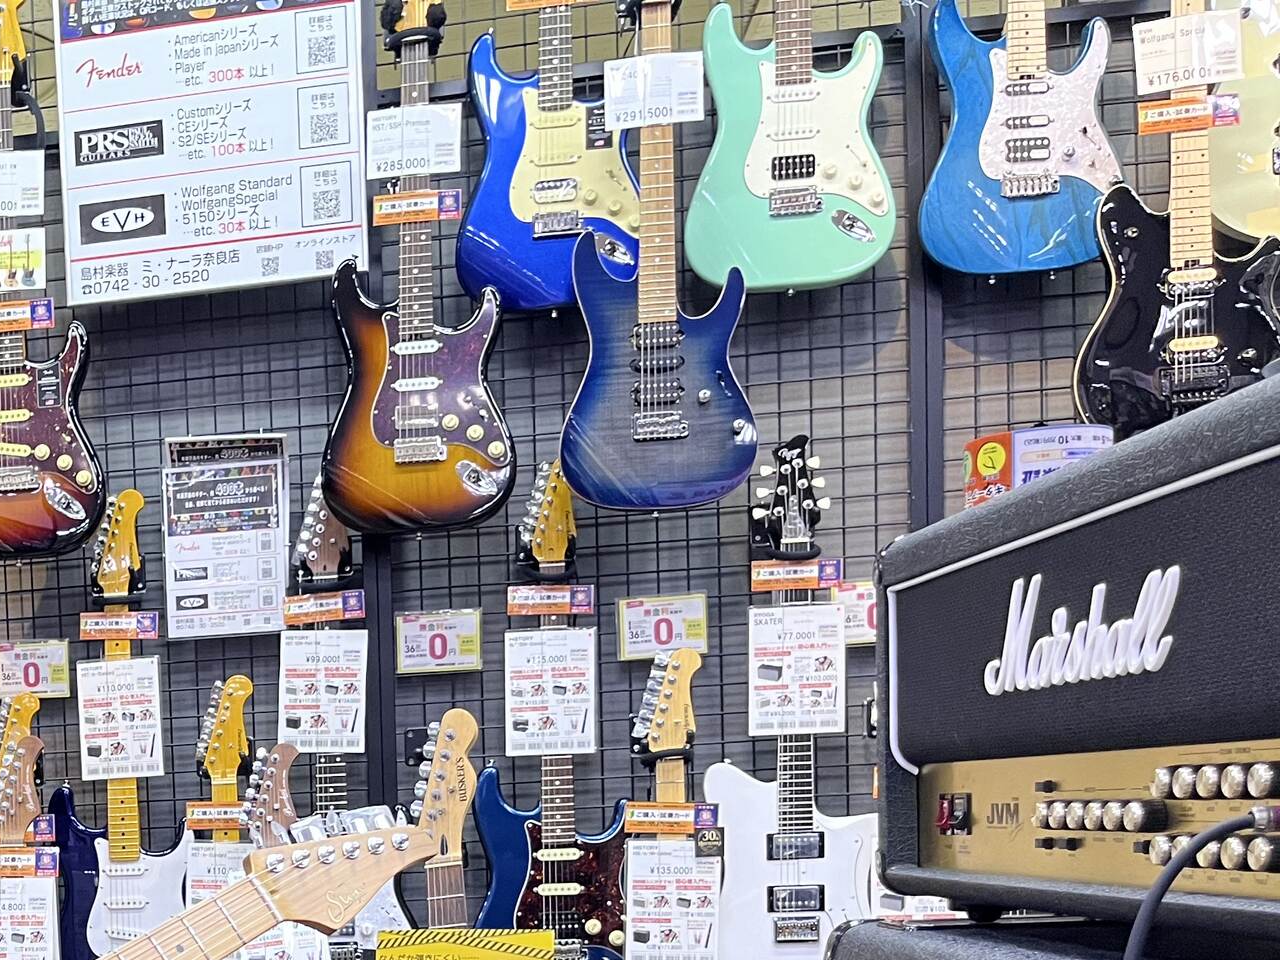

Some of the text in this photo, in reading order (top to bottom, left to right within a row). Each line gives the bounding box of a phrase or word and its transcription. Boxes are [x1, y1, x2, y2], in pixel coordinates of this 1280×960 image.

[75, 53, 144, 87] Fender
[175, 60, 207, 76] Player
[79, 128, 130, 154] PRS
[80, 150, 131, 163] GUITARS
[181, 175, 293, 201] Wolfgang Standard
[101, 210, 145, 231] EVH
[984, 565, 1180, 696] Marshall
[986, 802, 1020, 825] JVM
